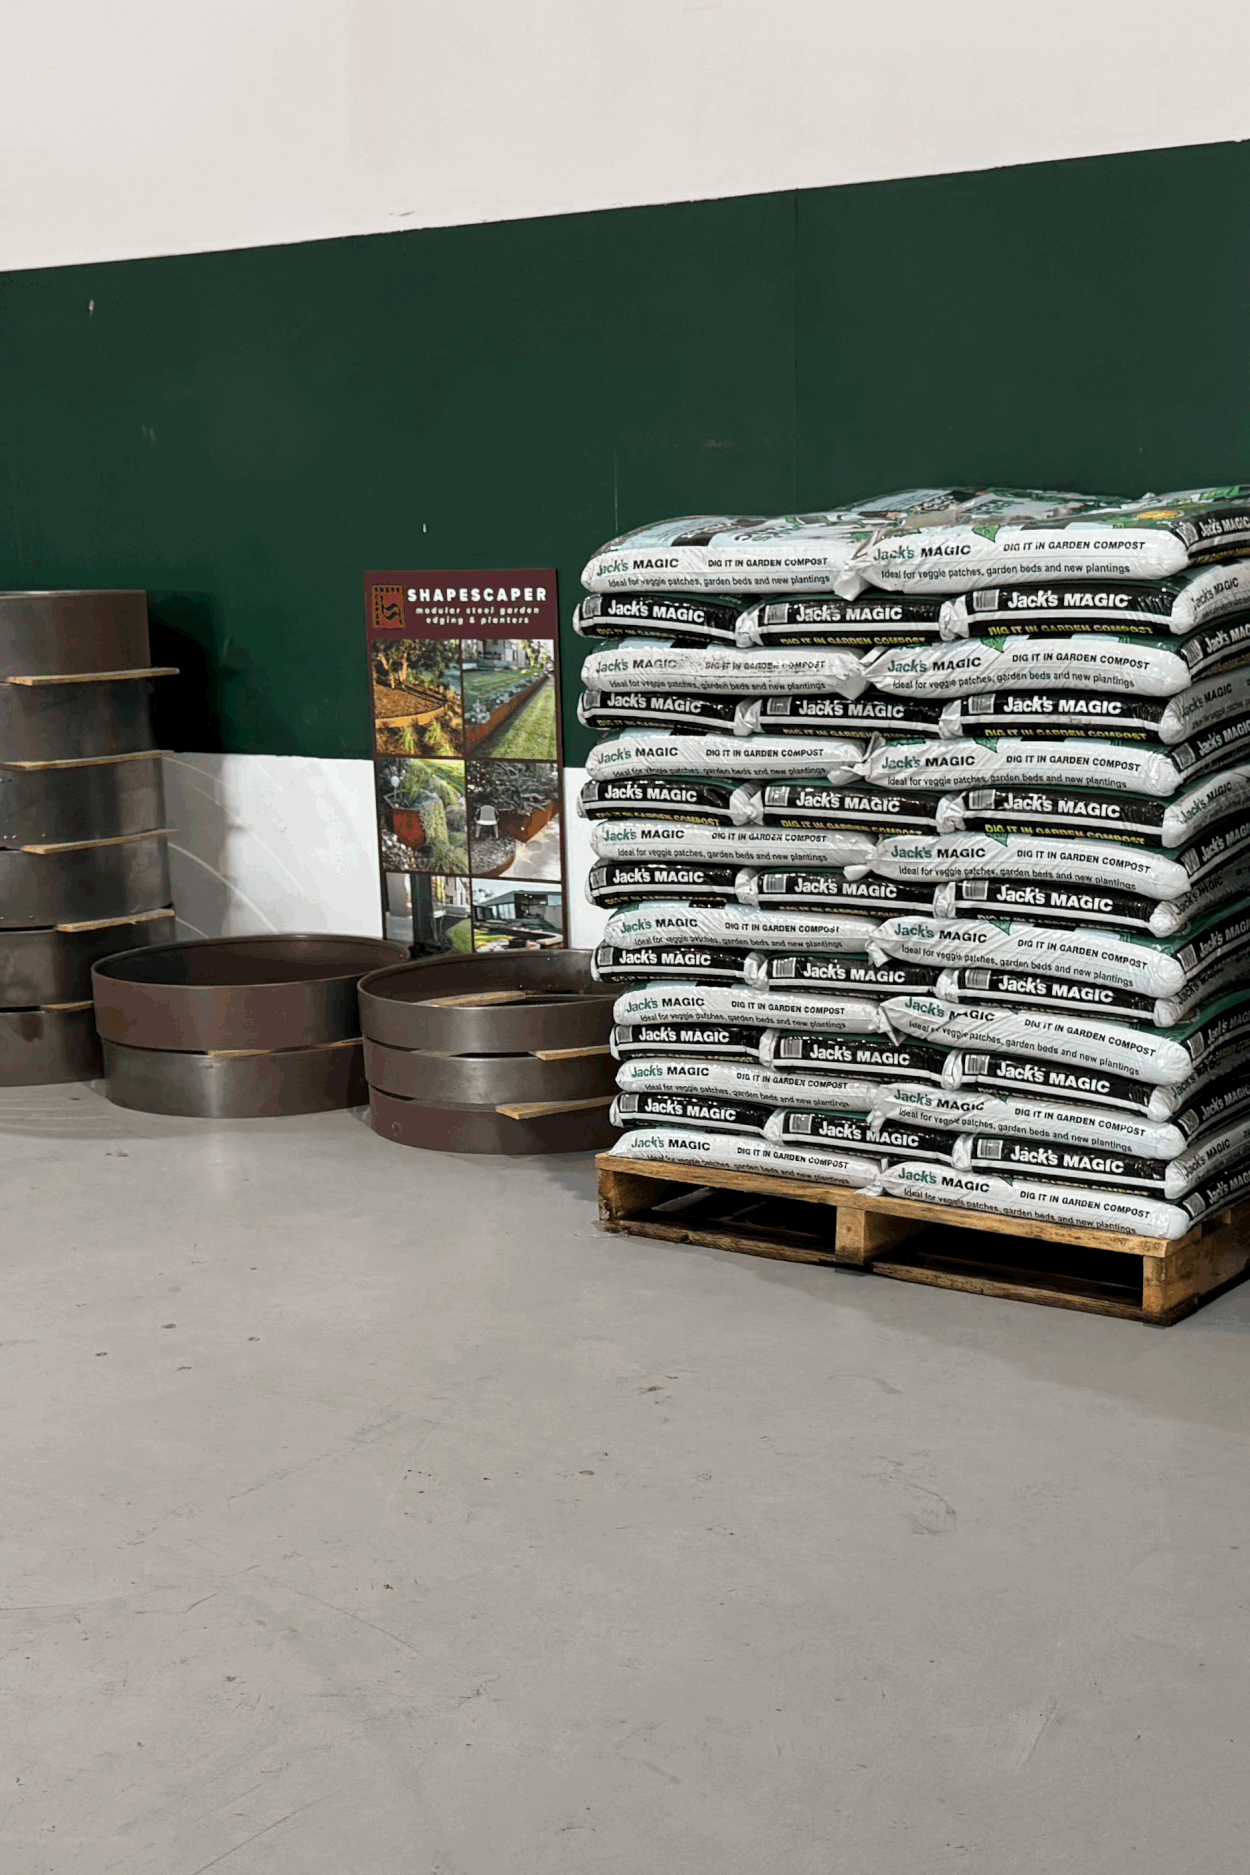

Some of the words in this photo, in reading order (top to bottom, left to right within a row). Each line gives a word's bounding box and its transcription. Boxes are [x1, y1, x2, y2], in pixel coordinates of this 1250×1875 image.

[1199, 520, 1222, 537] Jack's
[1222, 517, 1250, 533] MAGIC
[873, 548, 915, 561] Jack's
[920, 545, 971, 558] MAGIC
[1003, 543, 1021, 552] DIG
[1023, 543, 1032, 551] IT
[1035, 543, 1045, 551] IN
[1048, 541, 1090, 550] GARDEN
[1093, 541, 1145, 550] COMPOST
[596, 561, 629, 576] Jack's
[633, 559, 679, 570] MAGIC
[708, 559, 723, 567] DIG
[785, 558, 828, 566] COMPOST
[881, 569, 901, 579] Ideal
[902, 569, 916, 579] for
[918, 569, 946, 580] veggie
[948, 567, 985, 578] patches,
[986, 565, 1018, 576] garden
[1020, 564, 1042, 574] beds
[1044, 564, 1062, 573] and
[1064, 565, 1083, 573] new
[1086, 563, 1130, 575] plantings
[609, 579, 627, 588] Ideal
[628, 578, 640, 586] for
[641, 578, 666, 588] veggie
[667, 578, 702, 587] patches,
[704, 578, 730, 587] garden
[732, 577, 752, 585] beds
[755, 577, 770, 585] and
[791, 576, 830, 585] plantings
[408, 588, 546, 602] SHAPESCAPER
[1007, 591, 1059, 608] Jack's
[1063, 593, 1129, 608] MAGIC
[500, 607, 539, 615] garden
[608, 600, 648, 618] Jack's
[652, 606, 705, 622] MAGIC
[796, 605, 841, 622] Jack's
[846, 607, 902, 620] MAGIC
[426, 617, 463, 625] edging
[481, 617, 529, 625] planters
[887, 660, 928, 673] Jack's
[932, 657, 982, 671] MAGIC
[1012, 654, 1030, 662] DIG
[1032, 653, 1041, 661] IT
[1044, 653, 1054, 661] IN
[1056, 652, 1097, 662] GARDEN
[1099, 656, 1150, 670] COMPOST
[1003, 696, 1054, 713] Jack's
[1058, 698, 1122, 714] MAGIC
[882, 756, 921, 769] Jack's
[925, 755, 976, 767] MAGIC
[604, 784, 643, 799] Jack's
[646, 788, 698, 802] MAGIC
[604, 828, 638, 842] Jack's
[641, 829, 684, 839] MAGIC
[996, 886, 1046, 904] Jack's
[1050, 892, 1113, 911] MAGIC
[804, 964, 846, 979] Jack's
[850, 968, 906, 982] MAGIC
[638, 1027, 676, 1042] Jack's
[680, 1030, 729, 1042] MAGIC
[632, 1066, 663, 1078] Jack's
[667, 1066, 710, 1076] MAGIC
[996, 1061, 1046, 1082] Jack's
[1048, 1072, 1110, 1093] MAGIC
[1010, 1146, 1059, 1165] Jack's
[1063, 1155, 1124, 1173] MAGIC
[898, 1168, 936, 1184] Jack's
[942, 1177, 990, 1193] MAGIC
